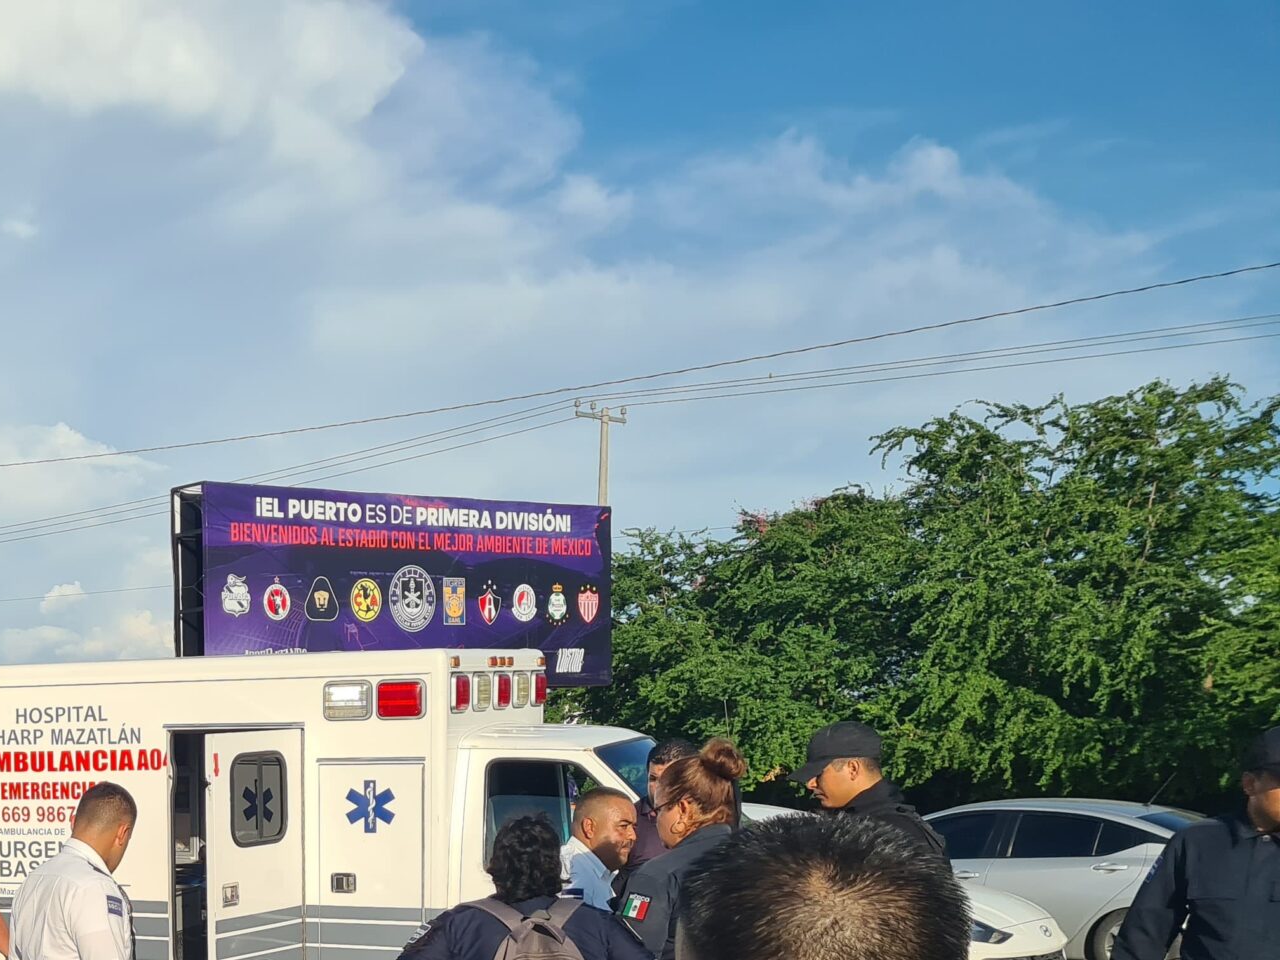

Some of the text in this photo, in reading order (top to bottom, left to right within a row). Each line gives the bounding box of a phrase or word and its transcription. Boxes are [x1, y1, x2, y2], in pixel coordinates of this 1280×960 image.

[255, 496, 572, 533] ¡EL PUERTO ES DE PRIMERA DIVISIÓN!
[230, 522, 593, 557] BIENVENIDOS AL ESTADIO CON EL MEJOR AMBIENTE DE MÉXICO
[15, 705, 108, 724] HOSPITAL
[51, 723, 141, 745] MAZATLÁN
[1, 806, 31, 823] 669
[54, 828, 65, 836] DE
